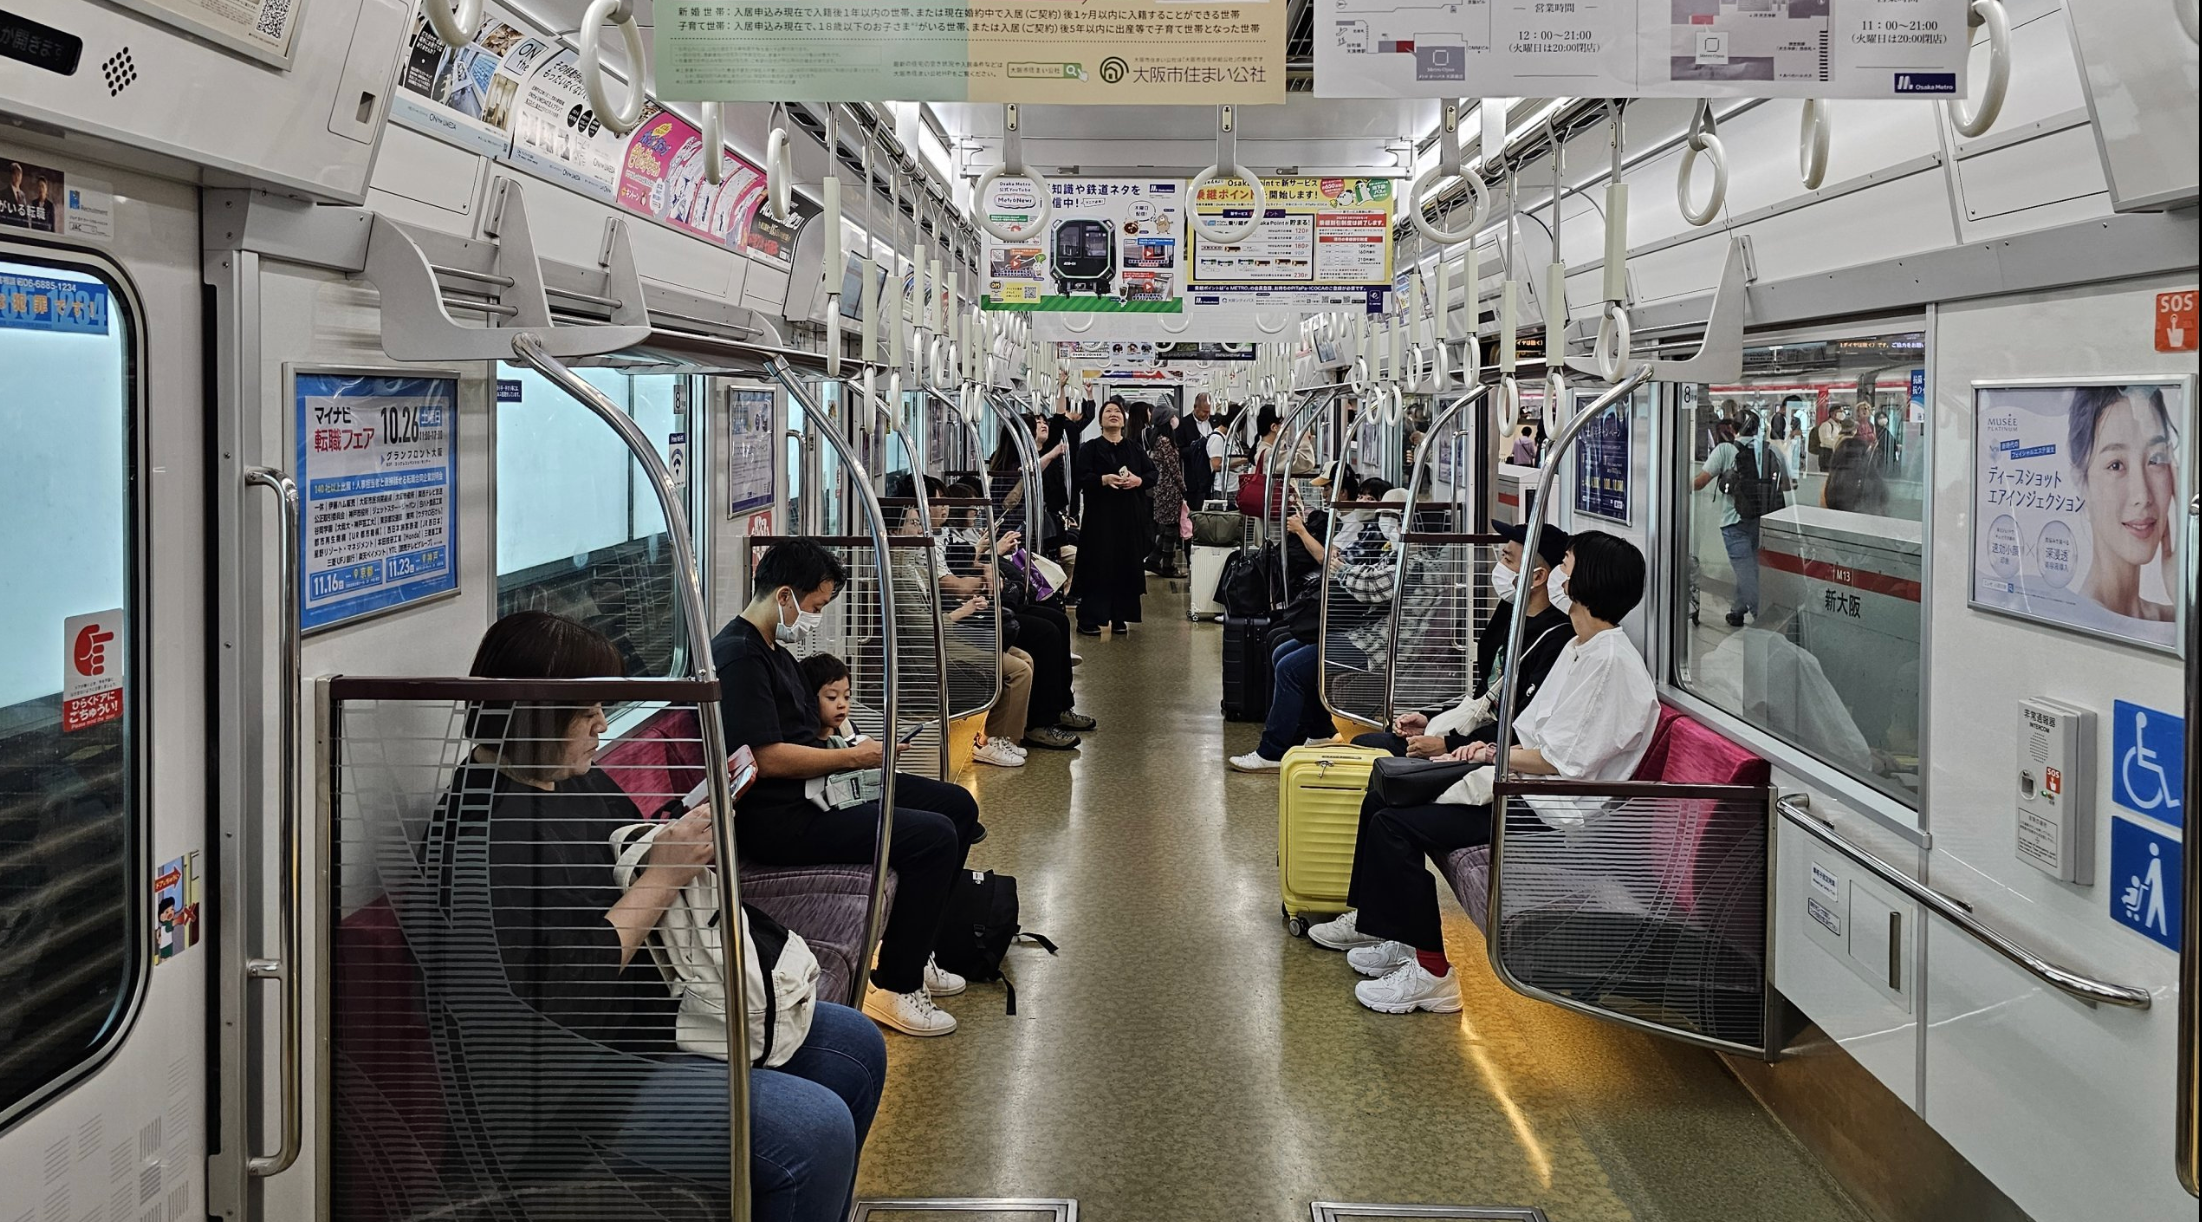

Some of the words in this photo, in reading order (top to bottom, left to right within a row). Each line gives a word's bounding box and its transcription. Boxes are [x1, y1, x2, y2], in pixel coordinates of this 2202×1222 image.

[1535, 3, 1575, 13] 営業時間
[518, 43, 542, 61] ON
[516, 58, 530, 72] the
[1133, 66, 1266, 83] 大阪市住まい公社
[1227, 179, 1250, 187] Osak
[2160, 293, 2193, 313] SOS
[675, 391, 681, 409] 8
[1684, 385, 1691, 403] 8
[314, 407, 351, 424] マイナビ
[380, 405, 419, 445] 10.26
[314, 427, 375, 453] 転職フェア
[1988, 466, 2062, 489] ディープショット
[1988, 489, 2086, 513] エアインジェクション
[1836, 569, 1850, 582] M13
[1825, 588, 1861, 619] 新大阪
[71, 691, 116, 710] ひらくドアに
[2047, 767, 2060, 779] SOS
